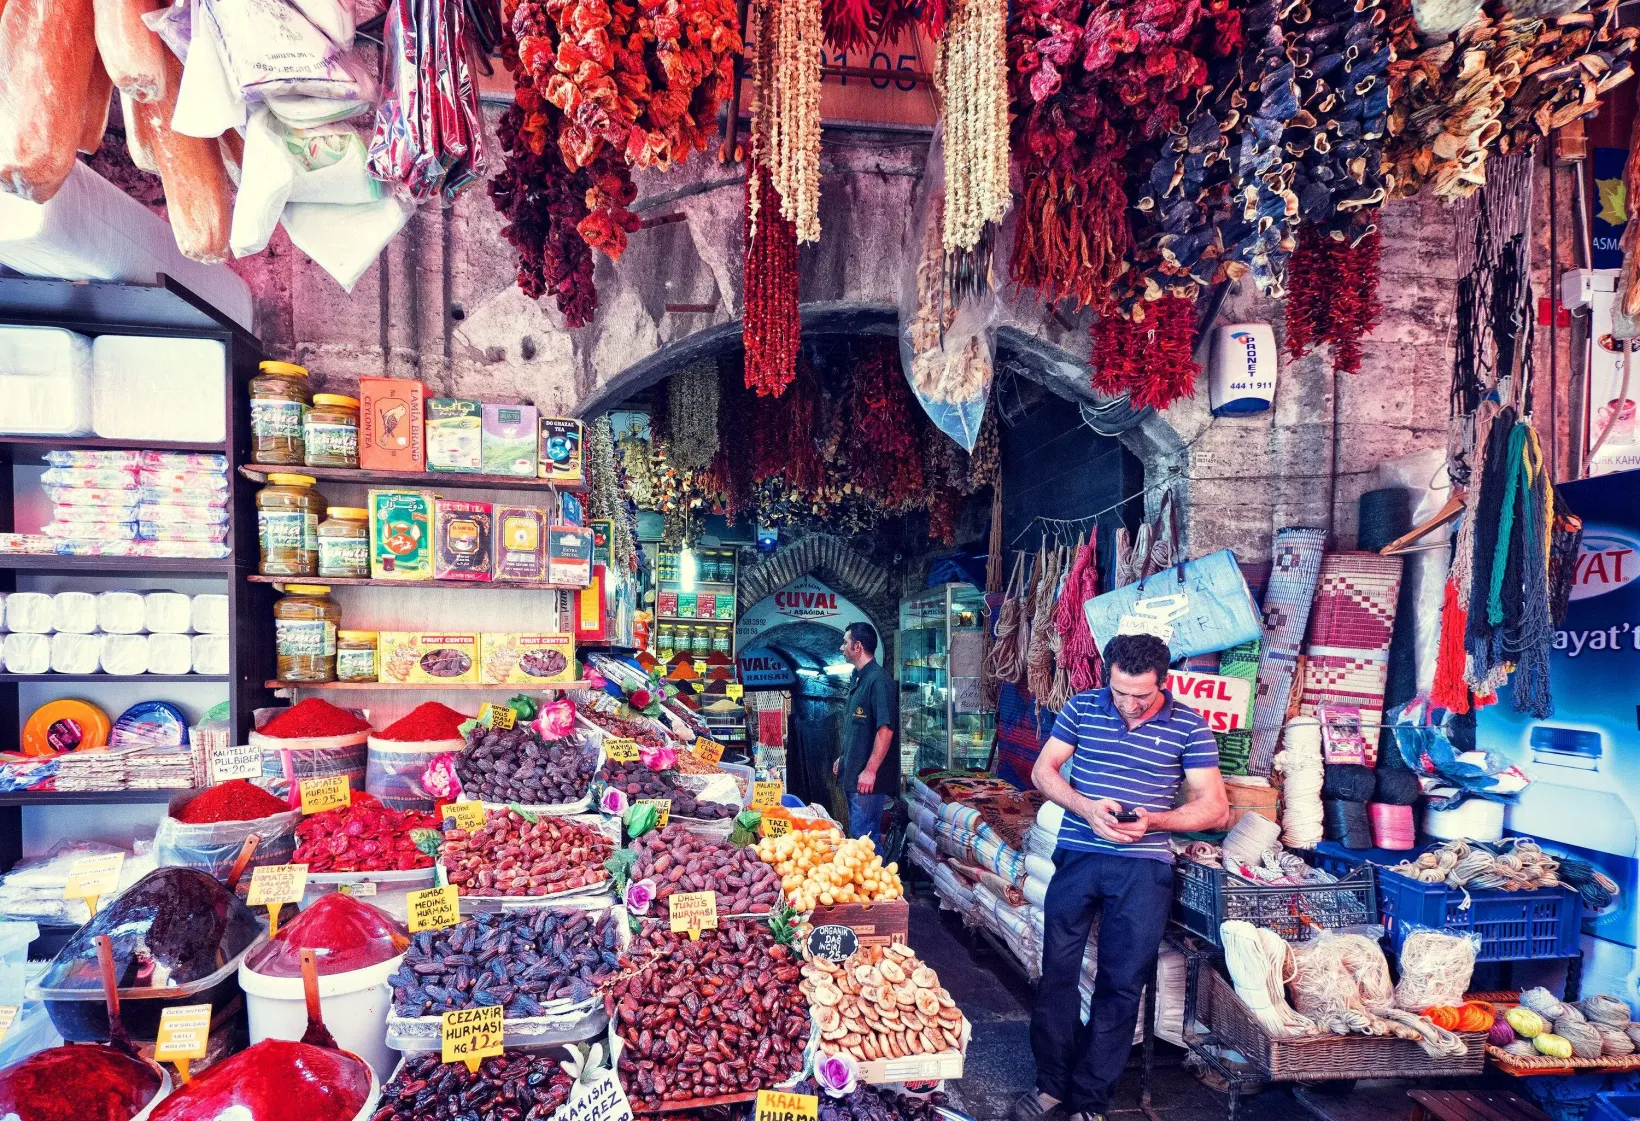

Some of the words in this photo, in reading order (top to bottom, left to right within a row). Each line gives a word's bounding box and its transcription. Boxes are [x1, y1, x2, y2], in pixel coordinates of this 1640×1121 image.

[1593, 237, 1620, 250] ASM
[1246, 337, 1257, 377] PRONET
[364, 396, 372, 431] CEYLON
[470, 505, 485, 513] TEA
[775, 591, 838, 610] ÇUVAL
[767, 819, 789, 827] TAZE
[419, 888, 445, 899] JUMBO
[677, 894, 703, 903] DALLI
[417, 904, 452, 918] HURMASI
[673, 900, 707, 910] TUNUS
[672, 908, 713, 920] HURMASI
[446, 1020, 501, 1041] HURMASI
[765, 1094, 805, 1110] KRAL
